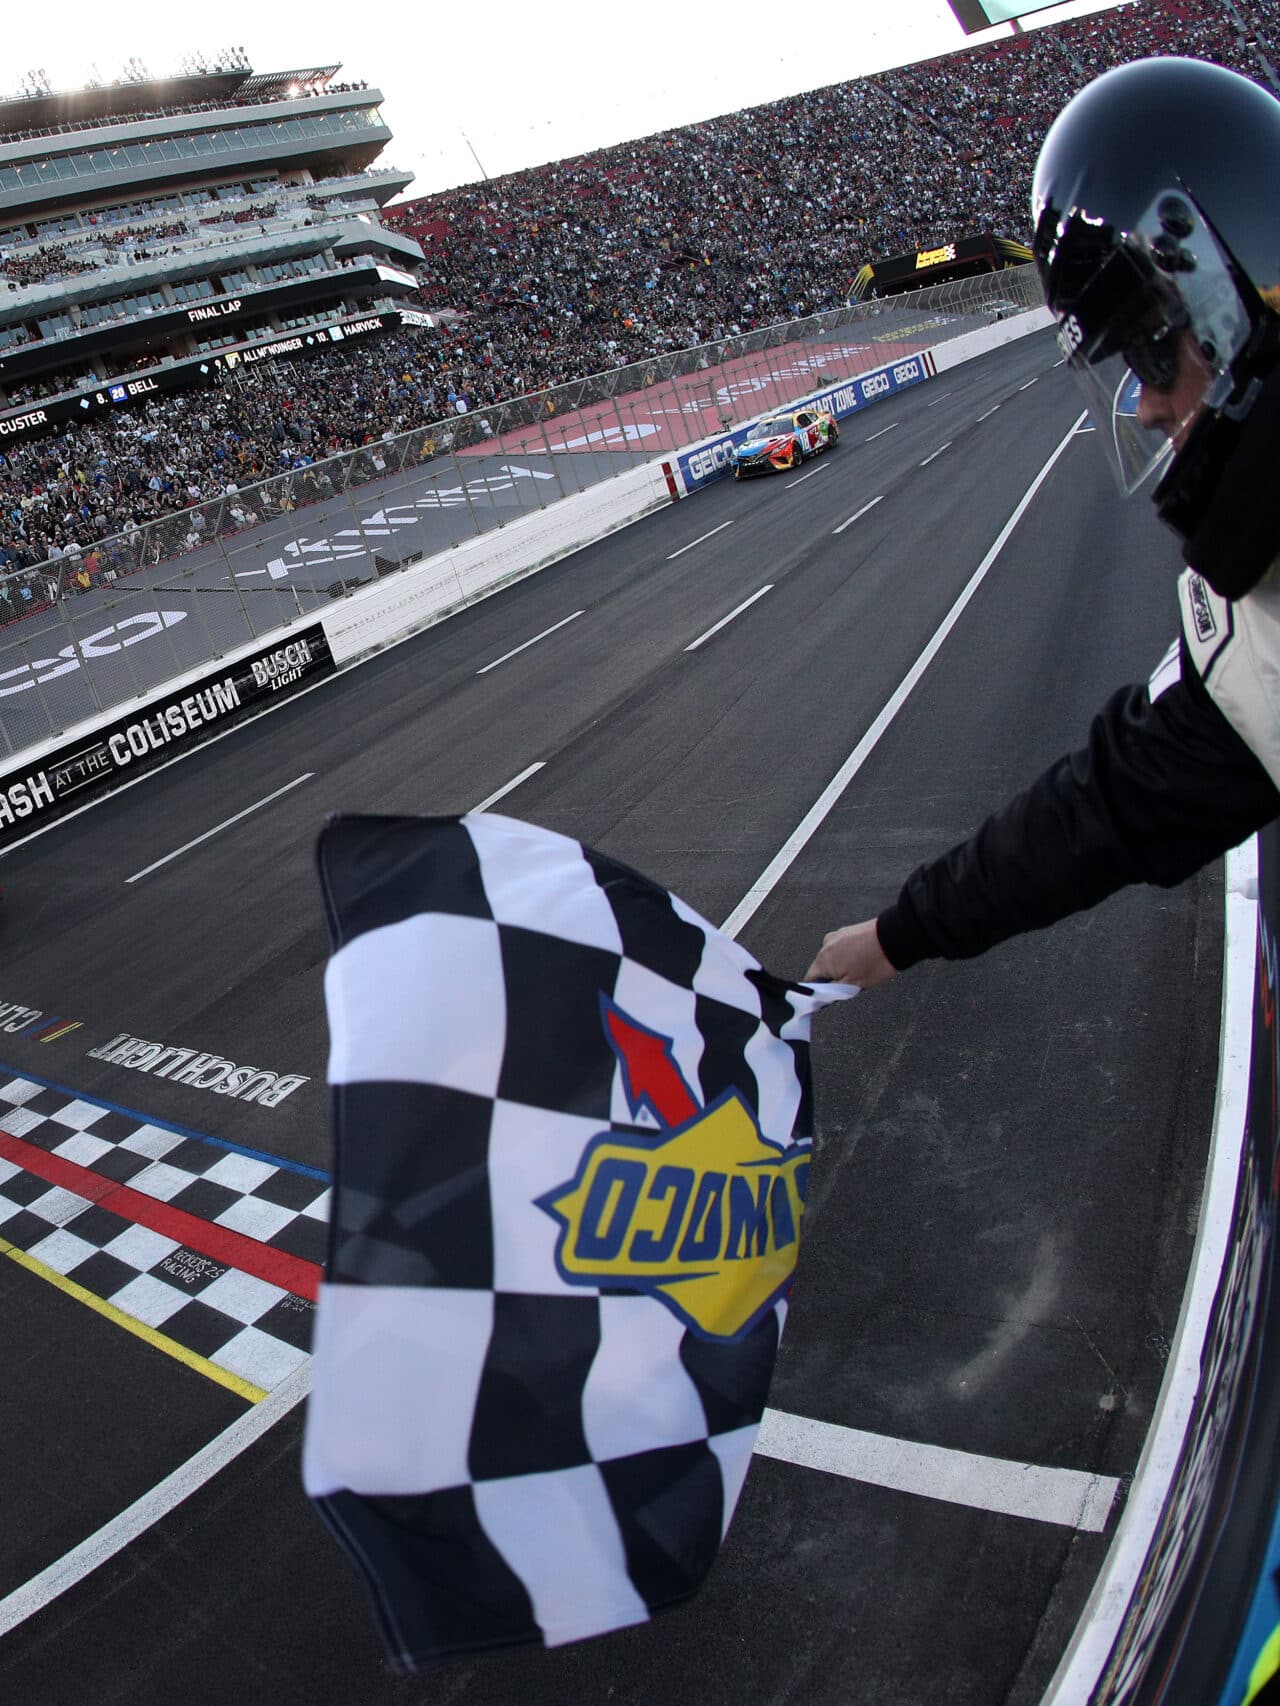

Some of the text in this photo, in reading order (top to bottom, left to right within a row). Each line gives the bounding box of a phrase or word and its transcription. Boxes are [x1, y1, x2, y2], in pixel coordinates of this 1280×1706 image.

[188, 300, 241, 322] FINAL LAP
[343, 318, 383, 337] HARVICK
[893, 361, 919, 384] GEICO
[128, 378, 158, 396] BELL
[861, 373, 889, 398] GEICO
[833, 386, 856, 413] ZONE
[688, 439, 735, 480] GEICO
[250, 639, 313, 688] BUSCH
[270, 665, 304, 691] LIGHT
[55, 764, 74, 791] AT
[75, 749, 111, 778] THE
[108, 677, 242, 768] COLISEUM
